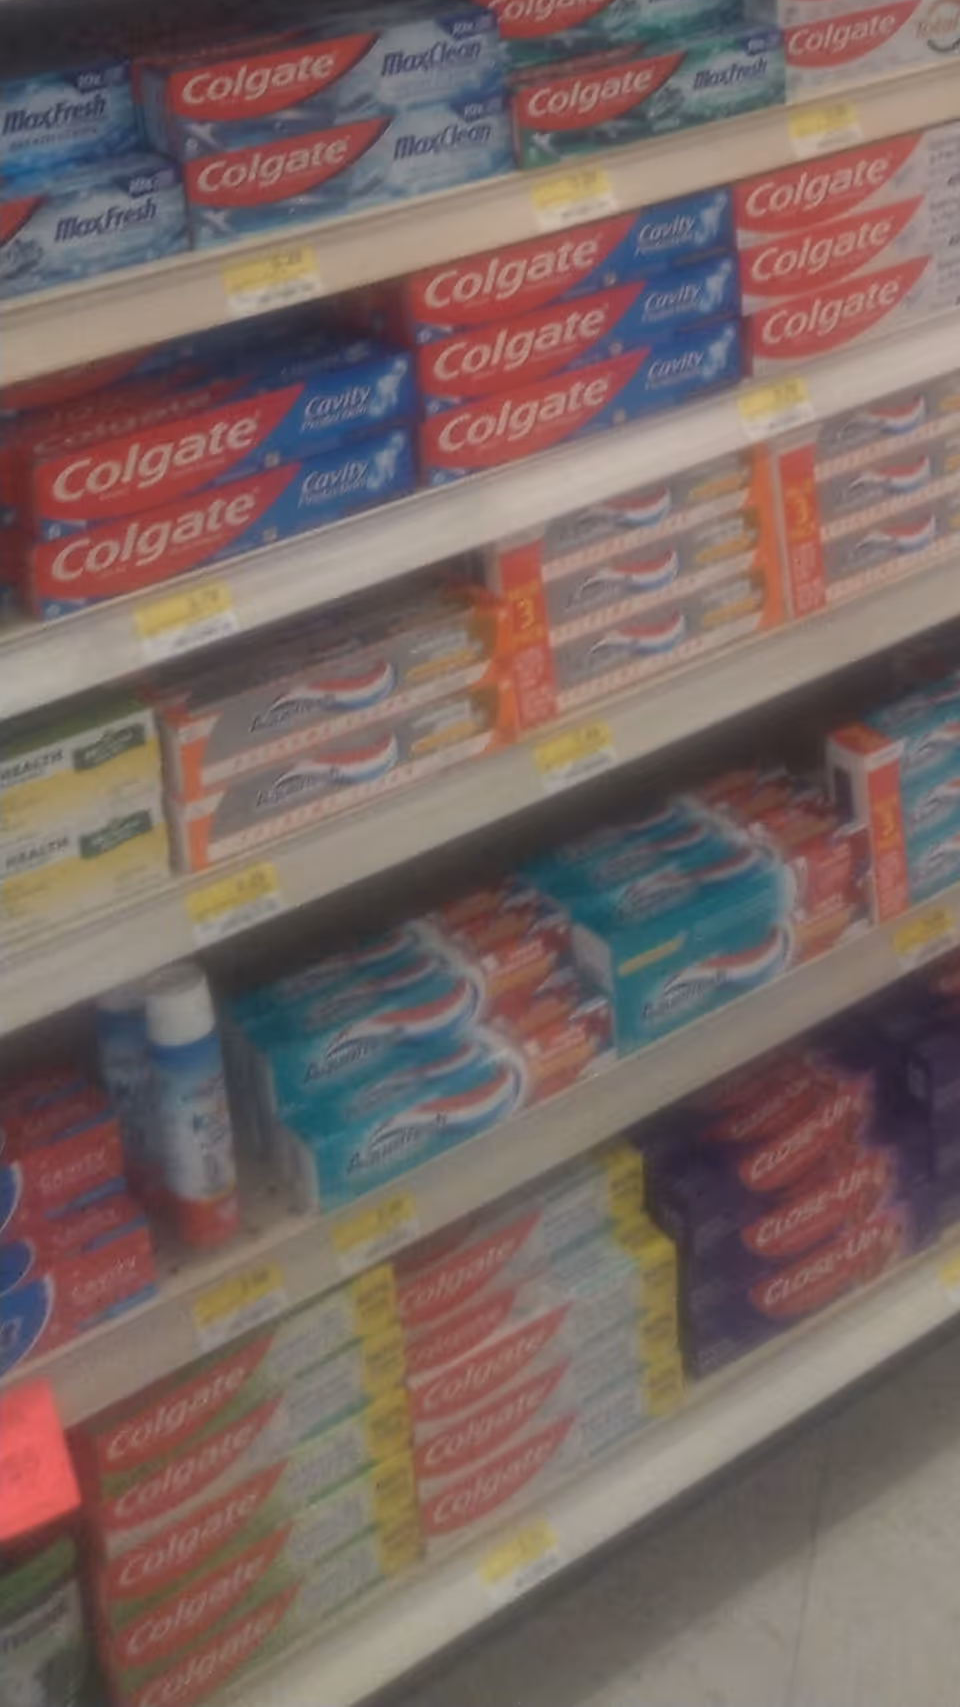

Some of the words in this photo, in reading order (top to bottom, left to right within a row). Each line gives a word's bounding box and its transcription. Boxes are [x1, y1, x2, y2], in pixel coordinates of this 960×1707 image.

[787, 14, 896, 56] Colgate
[915, 13, 960, 40] Total
[182, 49, 335, 106] Colgate
[381, 41, 483, 78] MaxClean
[2, 94, 107, 136] MaxFresh
[527, 65, 655, 118] Colgate
[197, 134, 351, 192] Colgate
[392, 121, 493, 161] MaxClean
[745, 155, 891, 218] Colgate
[54, 199, 158, 243] MaxFresh
[637, 213, 696, 243] Cavity
[751, 215, 894, 282] Colgate
[424, 235, 602, 309] Colgate
[643, 280, 702, 312] Cavity
[761, 278, 901, 344] Colgate
[432, 305, 608, 381] Colgate
[647, 349, 704, 380] Cavity
[304, 384, 371, 418] Cavity
[437, 374, 609, 452] Colgate
[51, 415, 260, 503] Colgate
[302, 459, 370, 493] Cavity
[50, 491, 257, 582] Colgate
[518, 597, 536, 631] 3
[423, 1328, 548, 1410] Colgate
[105, 1364, 246, 1463] Colgate
[423, 1388, 545, 1465] Colgate
[113, 1422, 253, 1518] Colgate
[431, 1438, 552, 1525] Colgate
[118, 1488, 259, 1588] Colgate
[126, 1549, 268, 1658] Colgate
